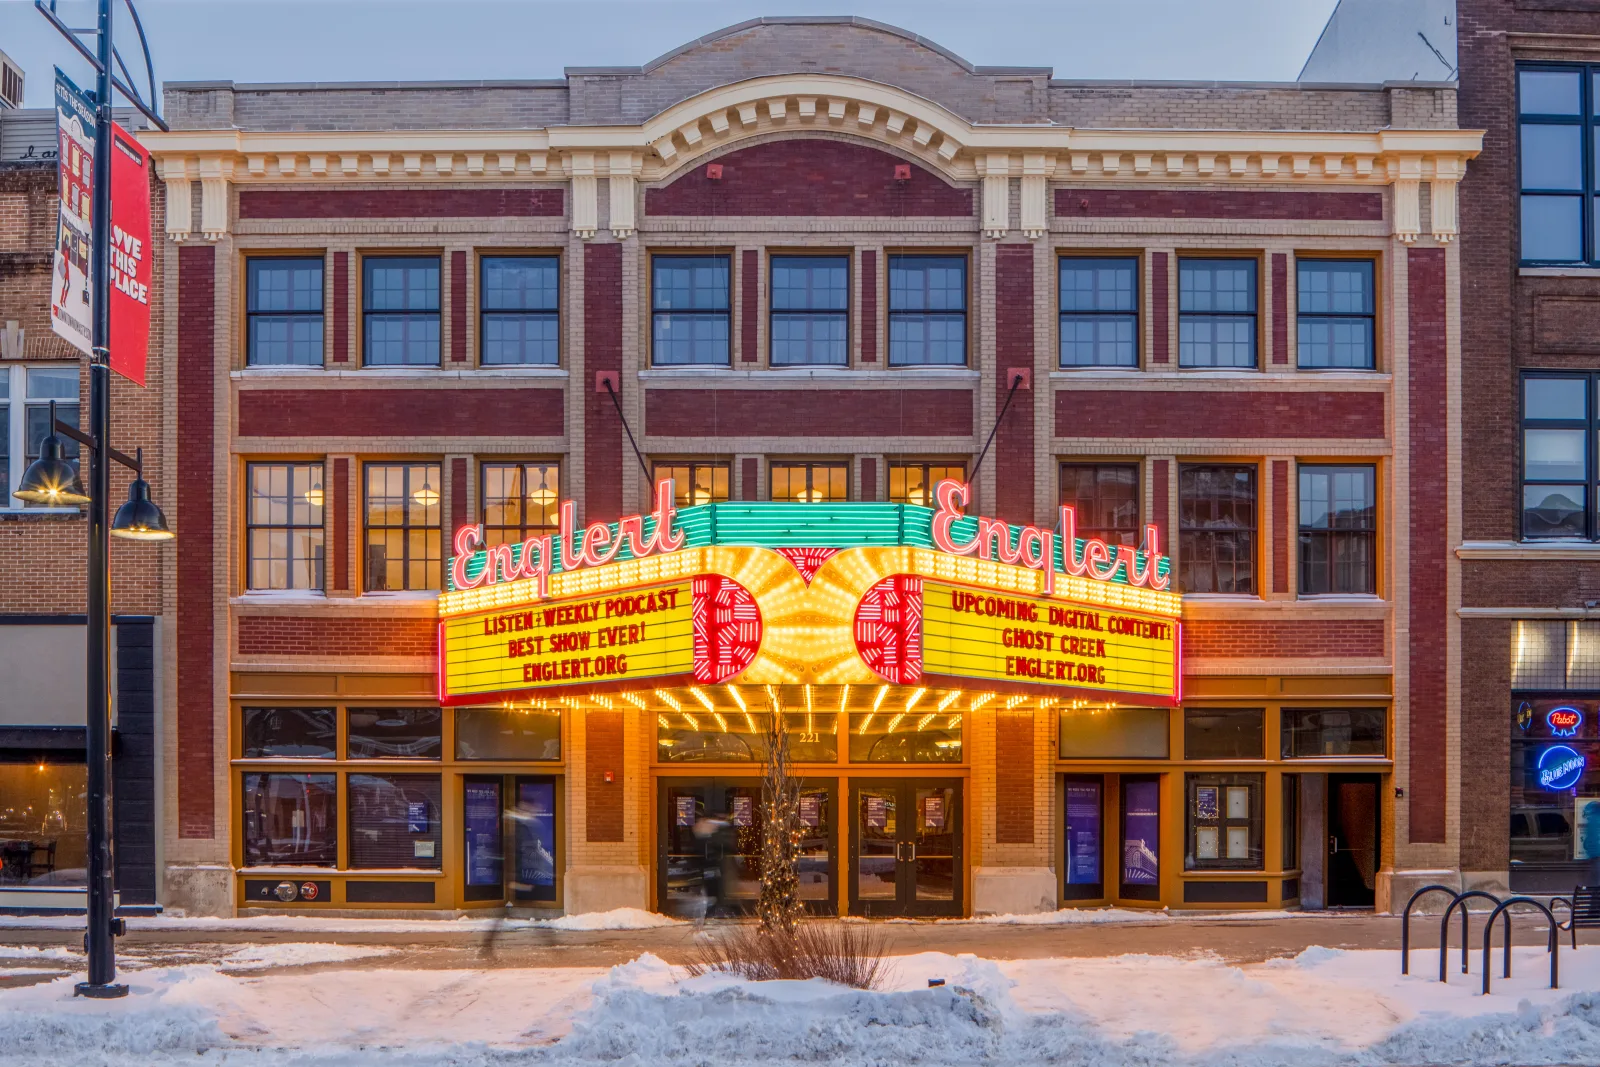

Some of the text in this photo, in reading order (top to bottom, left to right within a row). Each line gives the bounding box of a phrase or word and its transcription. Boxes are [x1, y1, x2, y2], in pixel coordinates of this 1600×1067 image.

[452, 478, 685, 598] Englert
[931, 478, 1171, 594] Englert
[484, 611, 533, 636] LISTEN
[543, 600, 600, 627] WEEKLY
[605, 588, 679, 619] PODCAST
[952, 590, 1038, 623] UPCOMING
[1049, 606, 1104, 632] DIGITAL
[508, 620, 646, 658] BEST SHOW EVER!
[1002, 627, 1106, 658] GHOST CREEK
[523, 653, 628, 682] ENGLERT.ORG
[1005, 655, 1105, 684] ENGLERT.ORG
[1551, 712, 1577, 725] Pabst
[799, 732, 821, 743] 221
